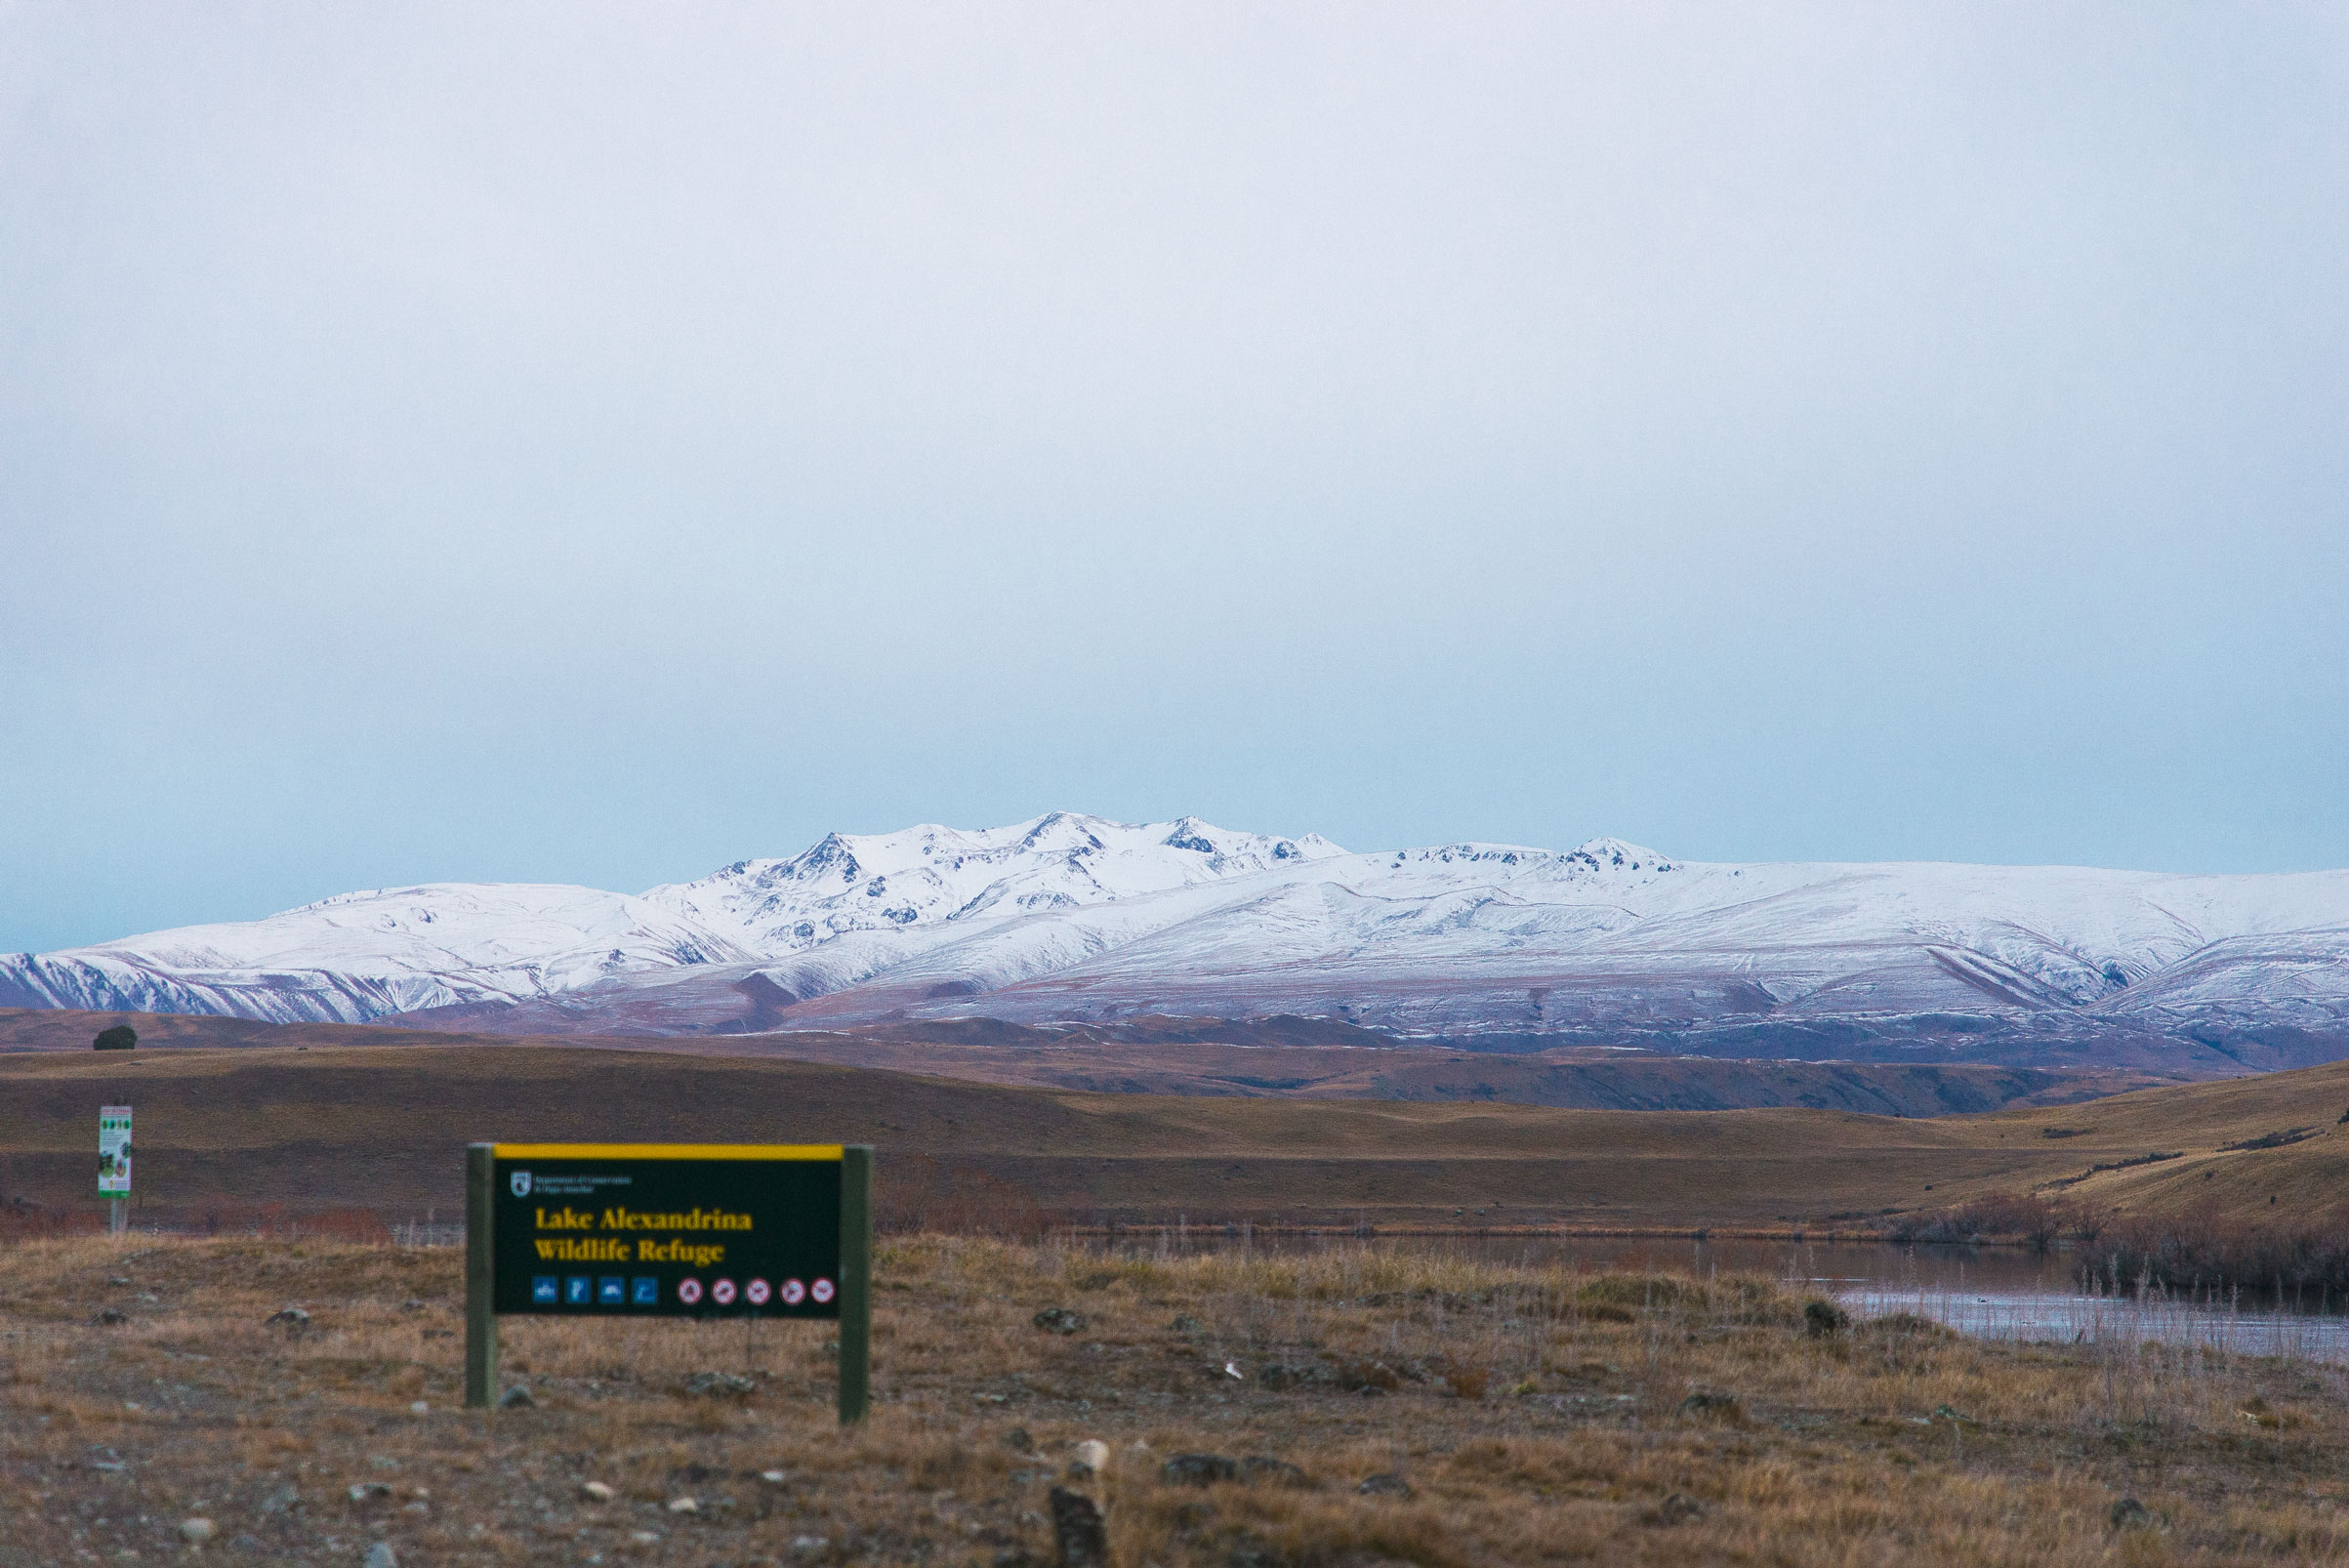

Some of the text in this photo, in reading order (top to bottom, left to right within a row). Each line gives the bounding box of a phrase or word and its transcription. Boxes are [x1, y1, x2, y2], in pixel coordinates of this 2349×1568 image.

[535, 1207, 752, 1230] Lake Alexandrina
[534, 1238, 724, 1266] Wildlife Refuge
